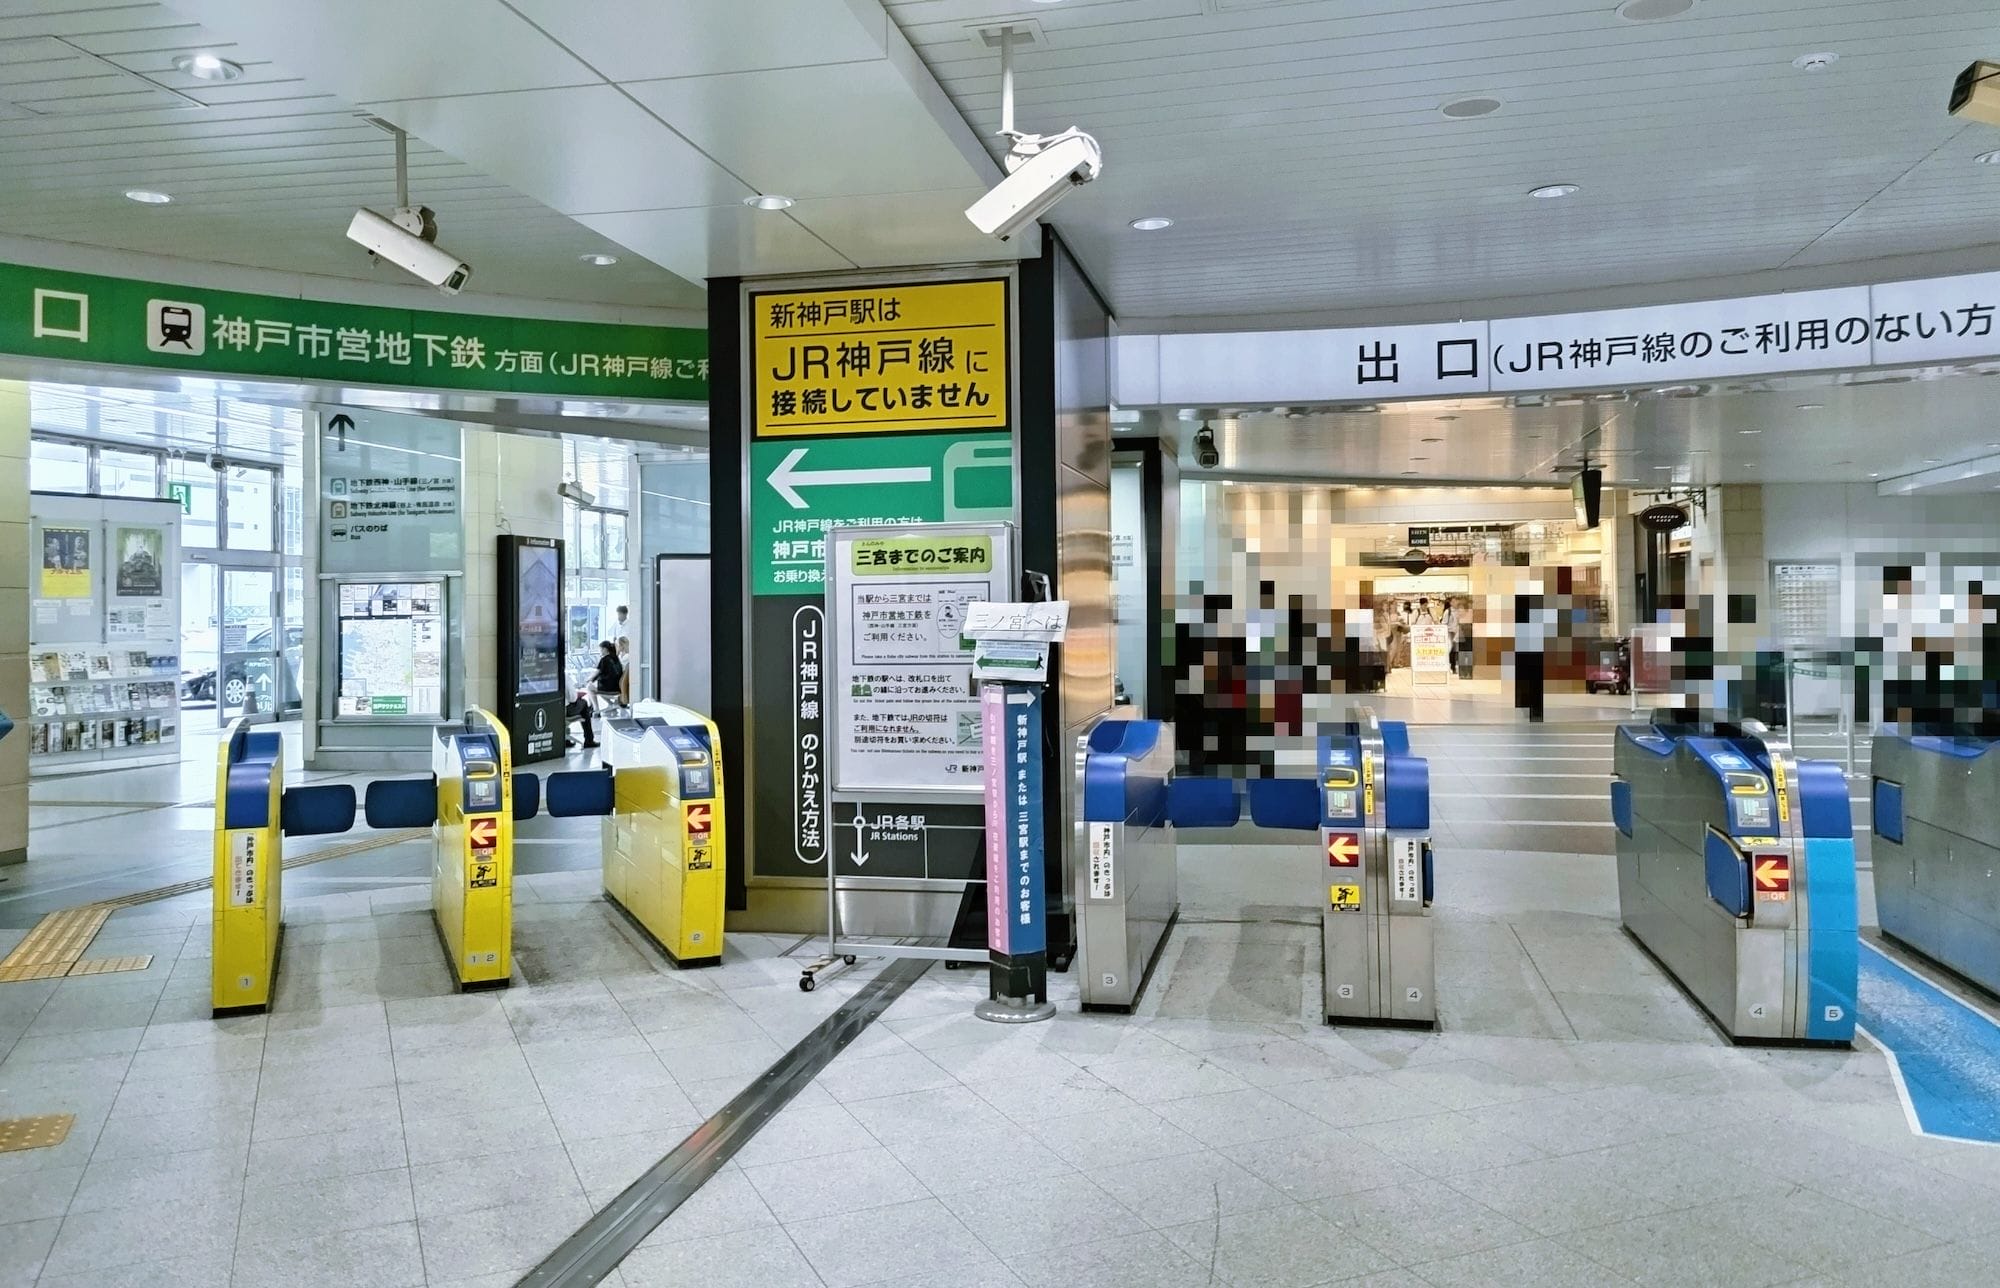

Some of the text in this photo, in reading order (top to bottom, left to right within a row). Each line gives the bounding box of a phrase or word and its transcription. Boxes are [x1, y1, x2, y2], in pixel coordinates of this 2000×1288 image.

[769, 297, 902, 330] 新神戸駅は
[33, 287, 90, 343] 口
[212, 313, 487, 372] 神戸市営地下鉄
[771, 335, 957, 382] JR神戸線
[770, 381, 991, 418] 接続していません
[351, 524, 388, 533] バスのりば
[856, 547, 985, 566] 三宮までのご案内
[858, 594, 932, 603] 当駅から三宮までは
[862, 610, 931, 620] 神戸市営地下鉄を
[973, 614, 1062, 630] 三ノ宮へは
[864, 632, 928, 642] ご利用ください。
[800, 620, 820, 848] JR神戸線 のりかえ方法
[854, 725, 920, 733] ご利用になれません。
[854, 736, 955, 744] 別途切符をお買い求めください。
[871, 815, 925, 830] JR各駅
[1017, 714, 1031, 925] 新神戸駅 または 三宮駅までのお客様
[870, 832, 918, 840] JR Stations
[1770, 892, 1786, 900] QR
